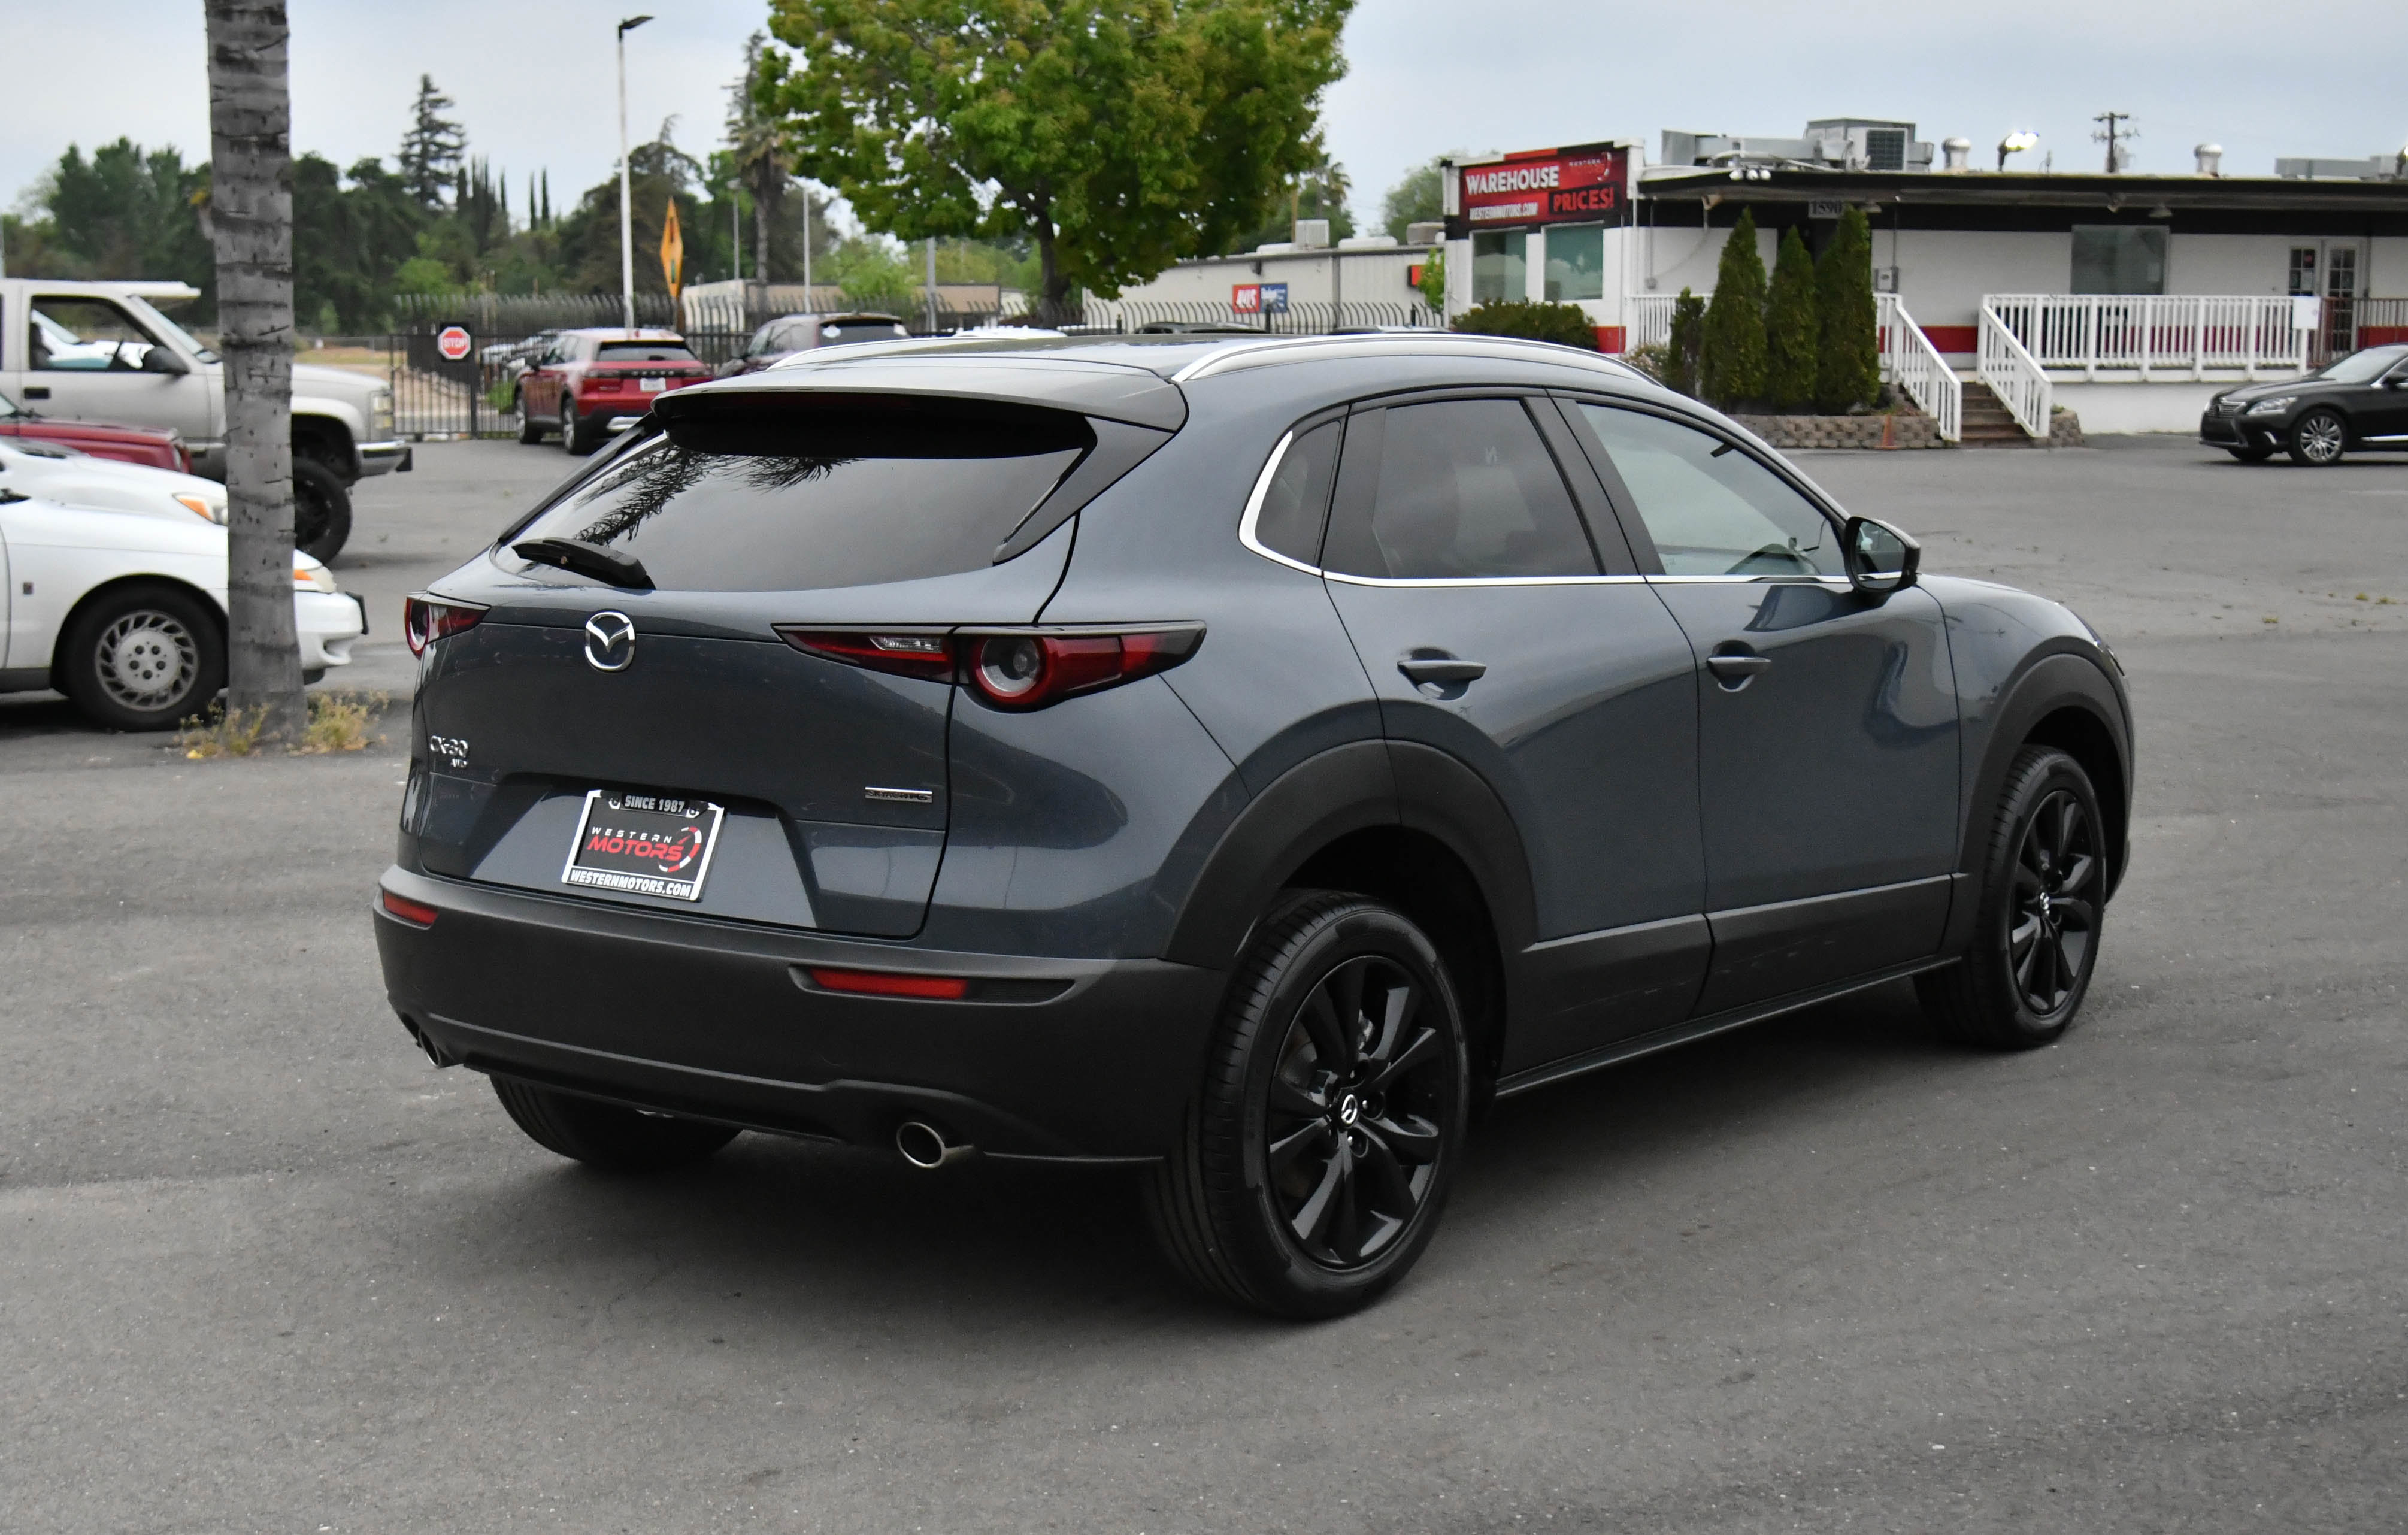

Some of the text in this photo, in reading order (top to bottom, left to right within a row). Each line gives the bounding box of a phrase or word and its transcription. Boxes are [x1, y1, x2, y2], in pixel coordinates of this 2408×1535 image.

[1466, 165, 1559, 195] WAREHOUSE
[1553, 187, 1614, 211] PRICES!
[444, 337, 467, 348] STOP
[624, 795, 685, 813] SINCE 1987
[592, 826, 672, 843] WESTERN
[587, 835, 684, 861] MOTORS
[570, 870, 692, 897] WESTERNMOTORS.COM
